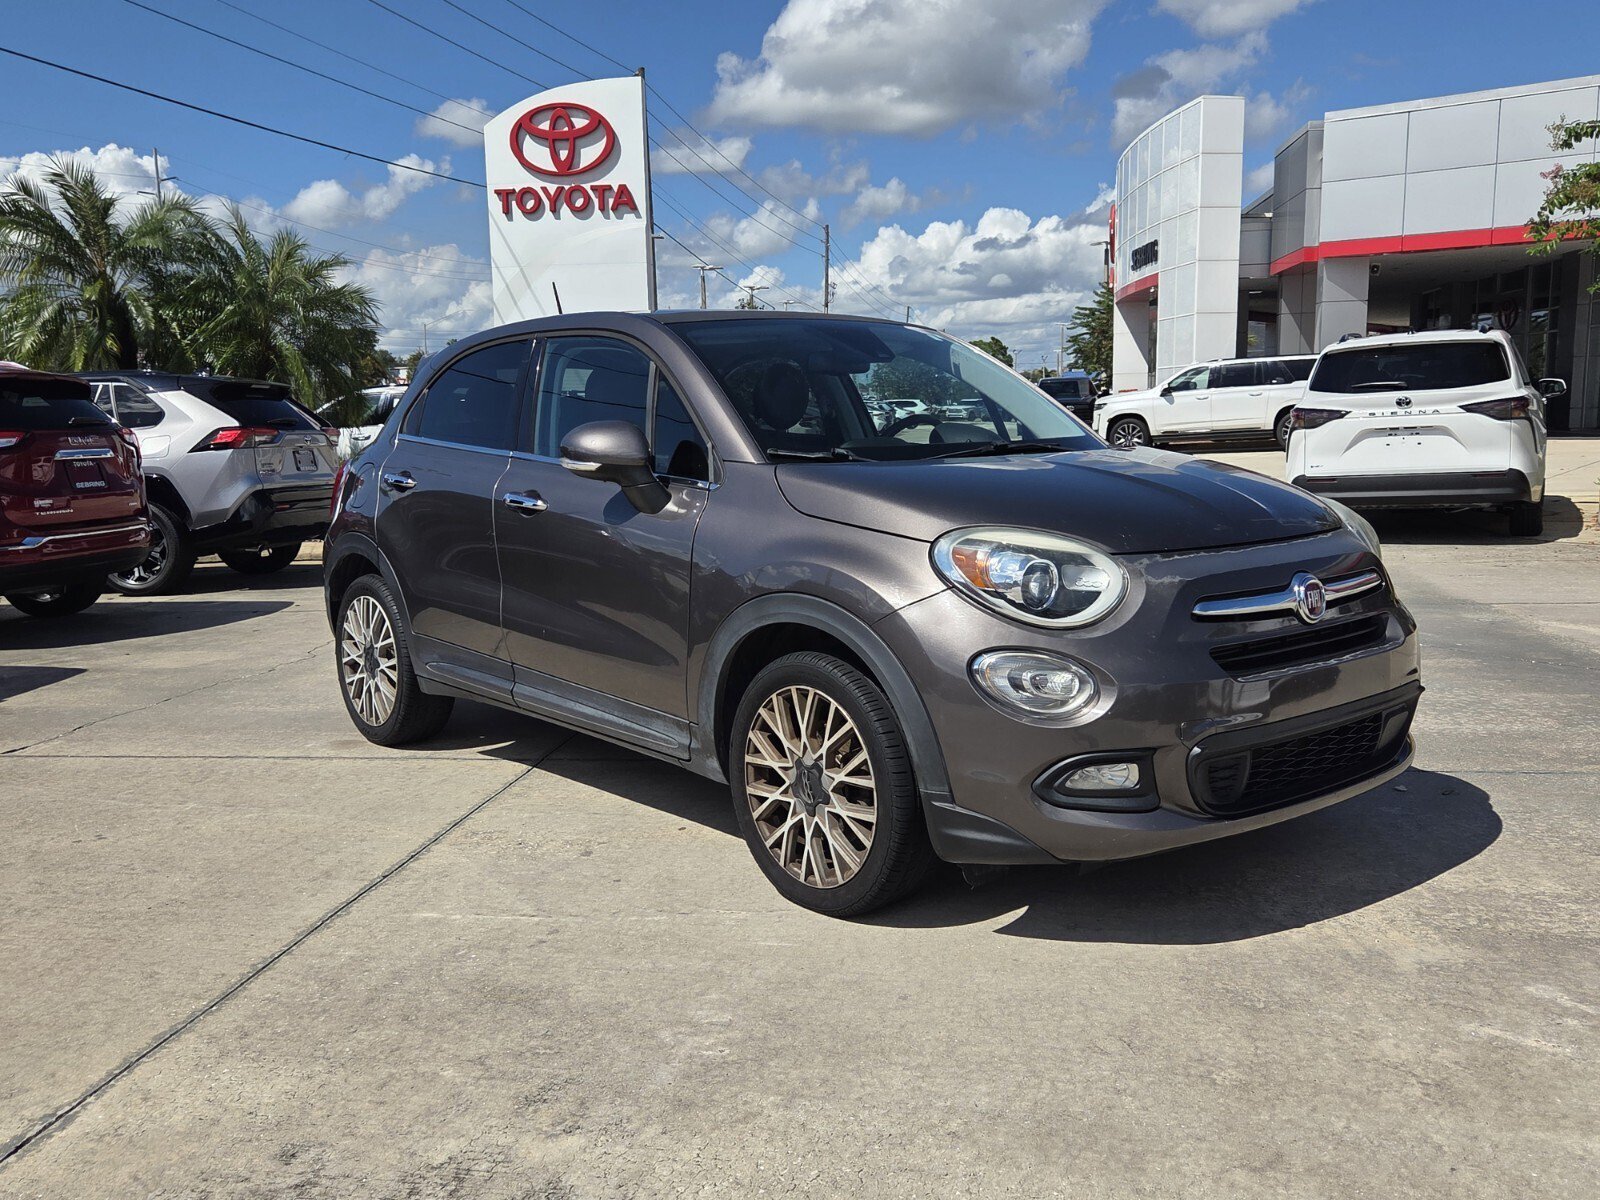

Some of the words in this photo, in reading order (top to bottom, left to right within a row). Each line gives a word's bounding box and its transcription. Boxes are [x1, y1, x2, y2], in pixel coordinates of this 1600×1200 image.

[494, 183, 638, 214] TOYOTA
[75, 480, 106, 489] SEBRING
[1307, 589, 1320, 609] FIAT
